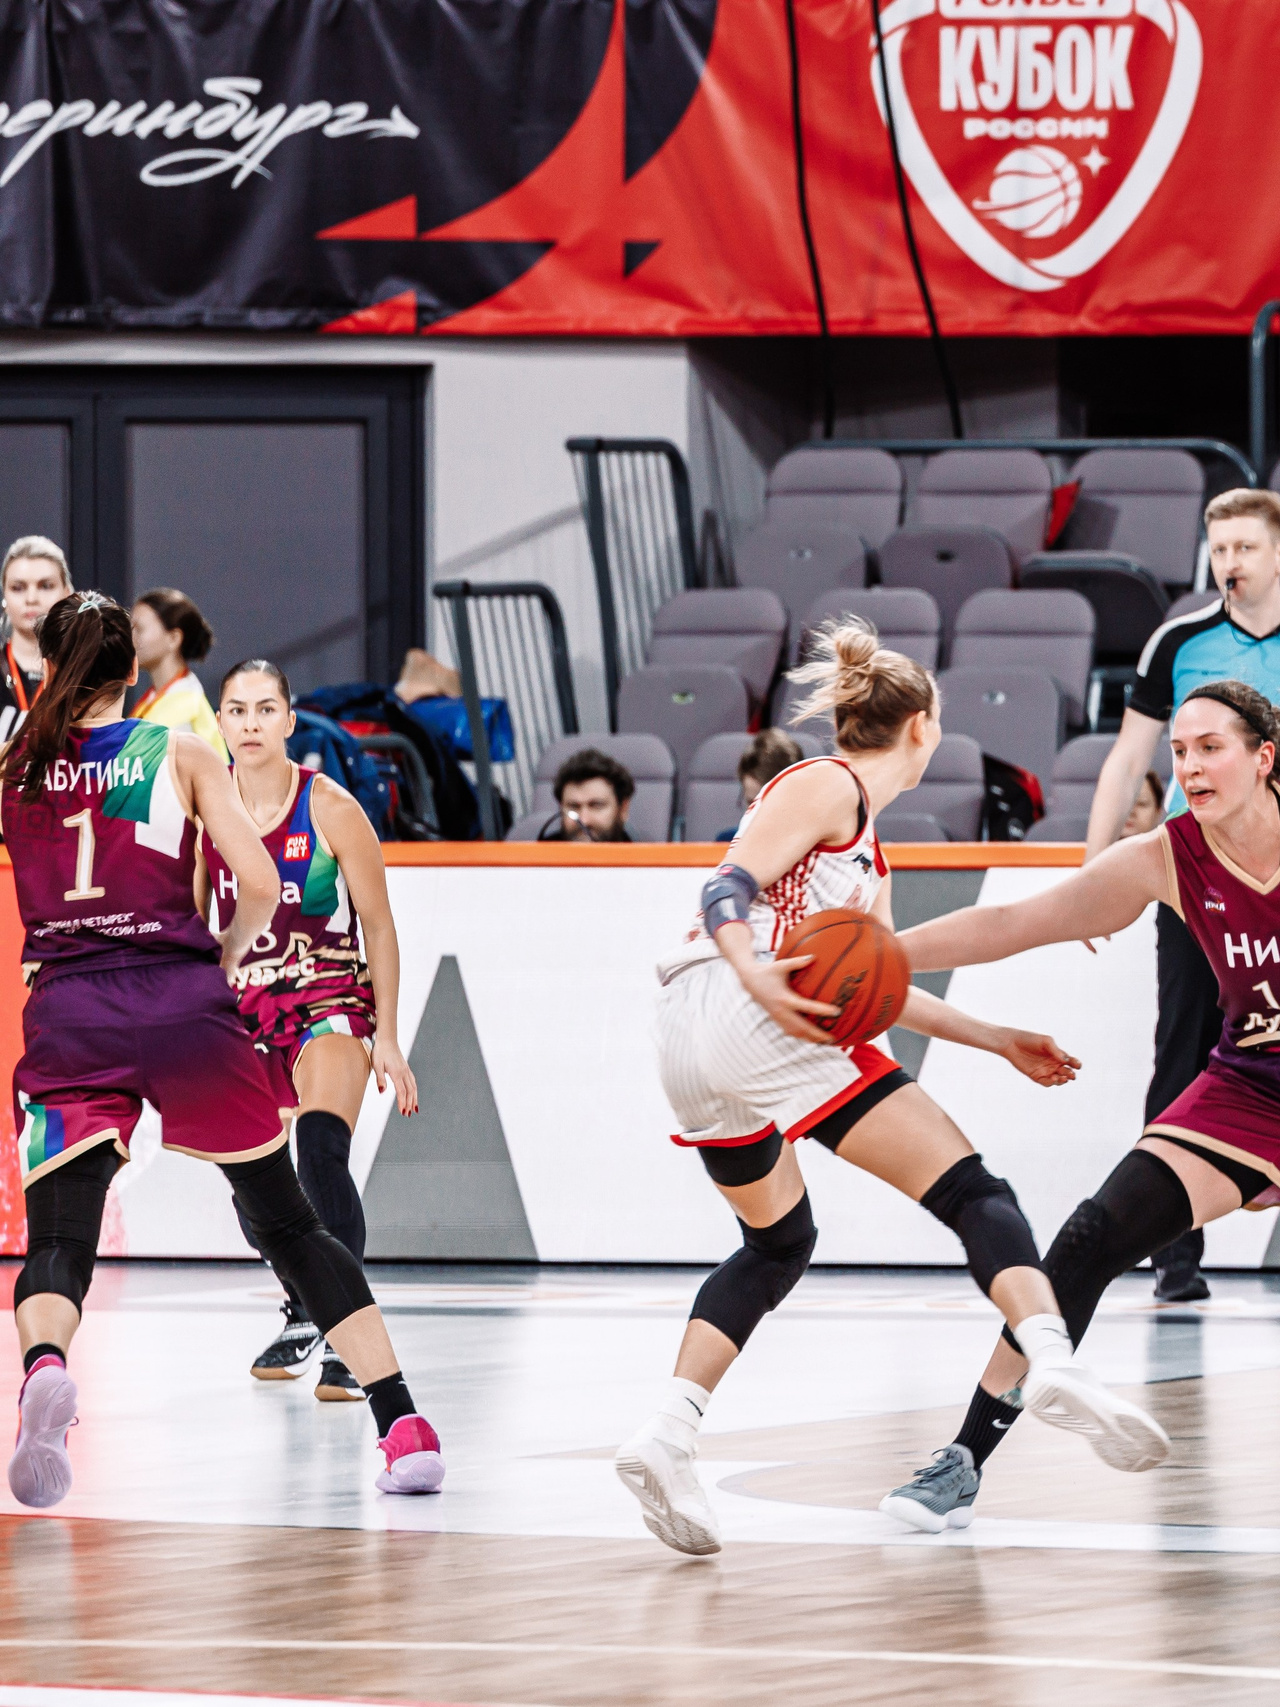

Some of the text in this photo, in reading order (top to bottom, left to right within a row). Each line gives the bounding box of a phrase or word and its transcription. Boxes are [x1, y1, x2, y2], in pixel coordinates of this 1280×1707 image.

[940, 25, 1135, 112] КУБОК
[0, 76, 420, 188] еринбург
[963, 117, 1109, 139] РОССИИ
[63, 808, 105, 901] 1
[219, 869, 302, 904] На
